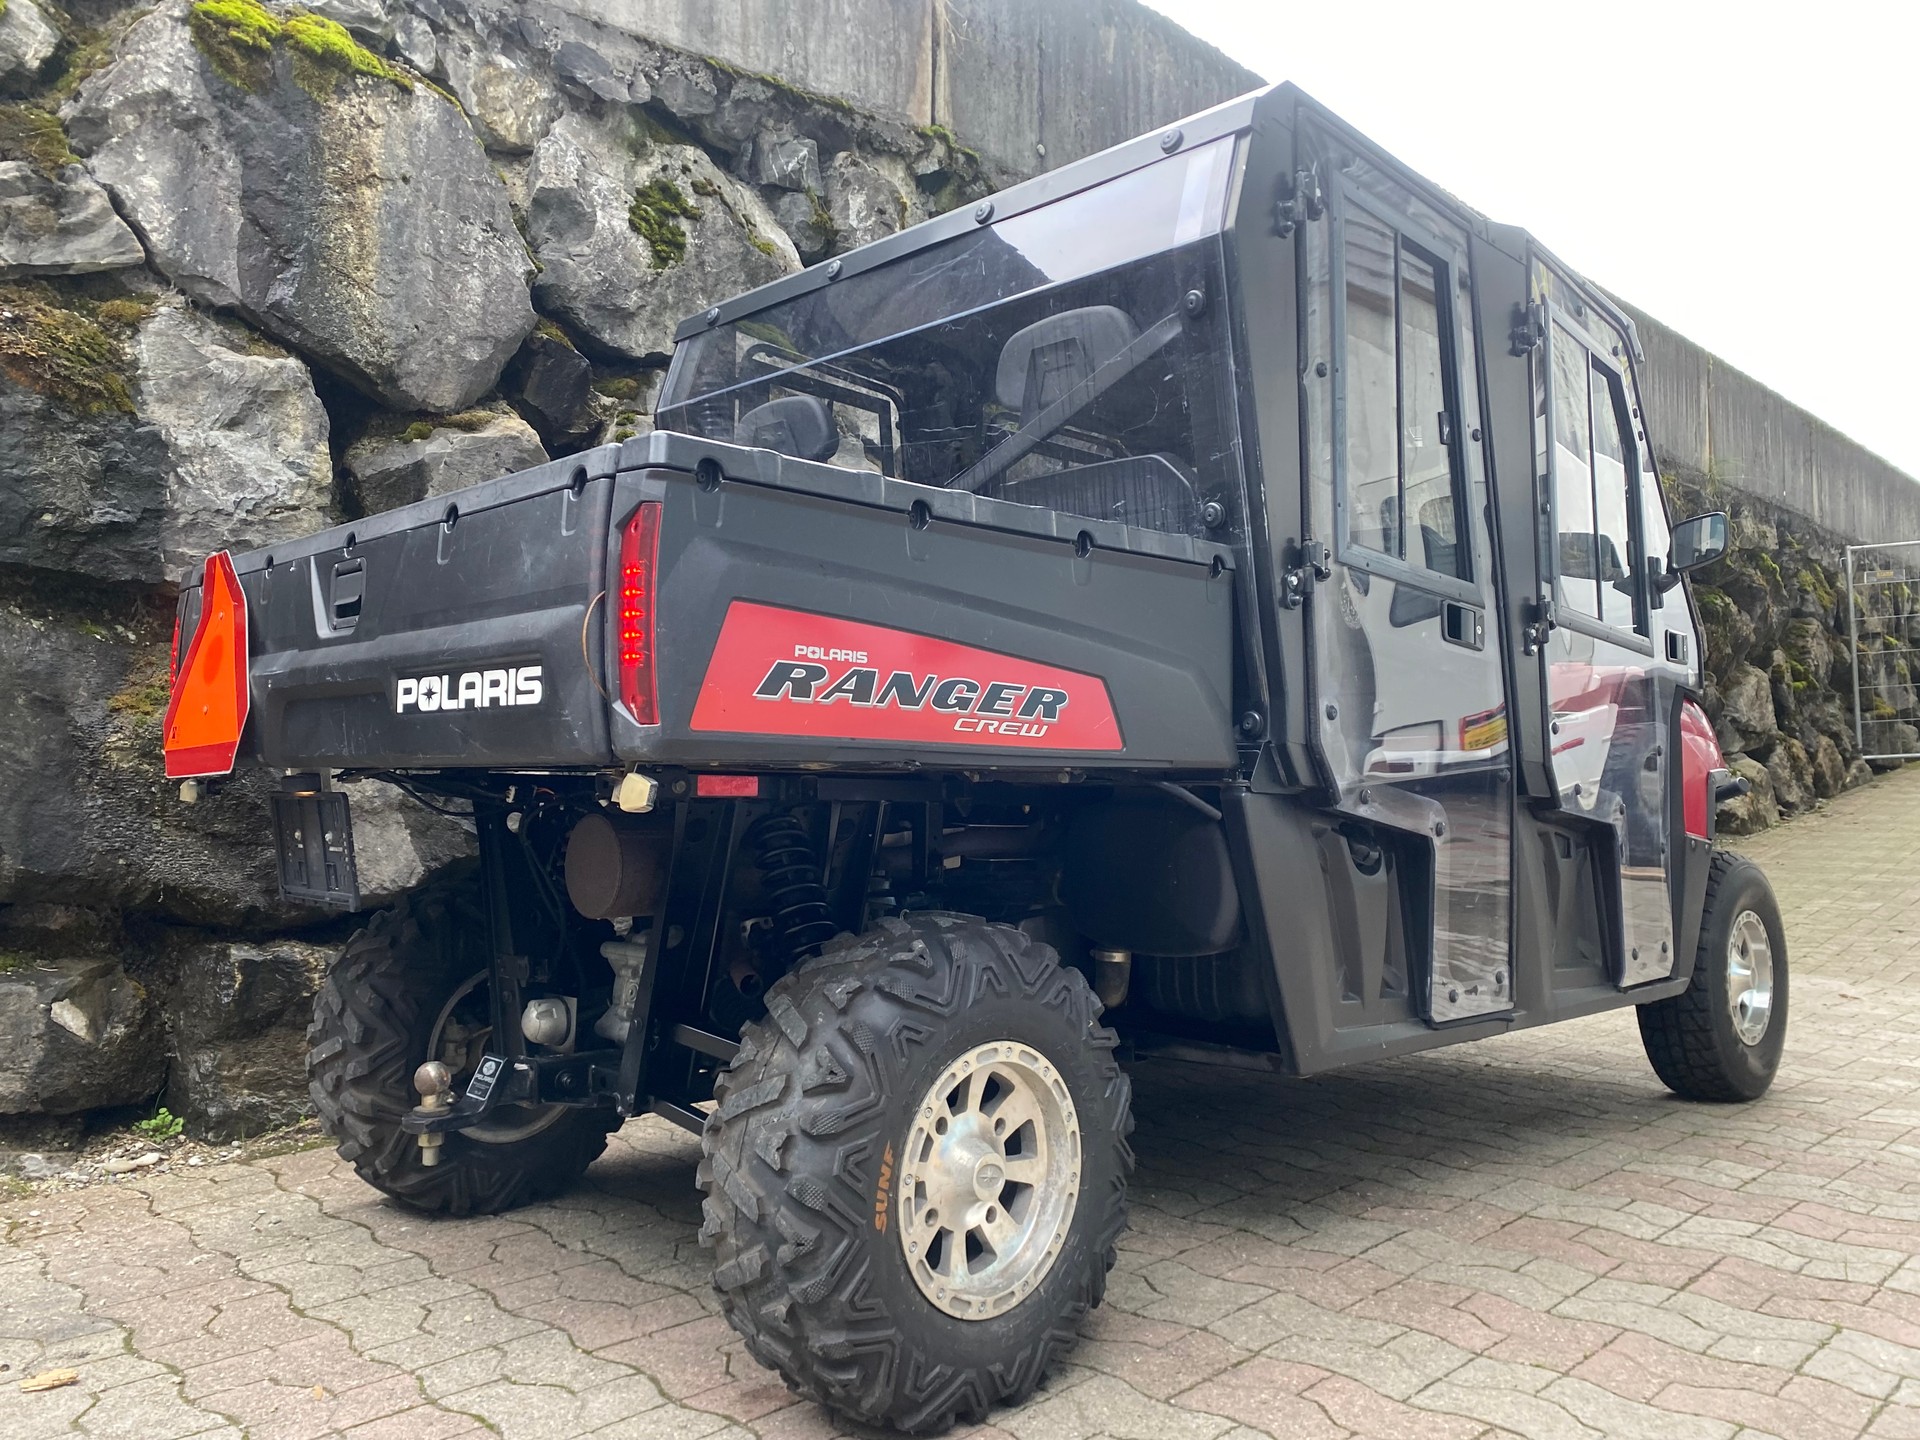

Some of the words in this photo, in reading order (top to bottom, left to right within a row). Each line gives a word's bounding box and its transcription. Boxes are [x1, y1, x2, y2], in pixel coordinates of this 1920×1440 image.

[794, 644, 868, 664] POLARIS
[396, 665, 543, 714] POLARIS
[753, 660, 1070, 723] RANGER
[953, 717, 1049, 738] CREW
[875, 1140, 894, 1234] SUNF
